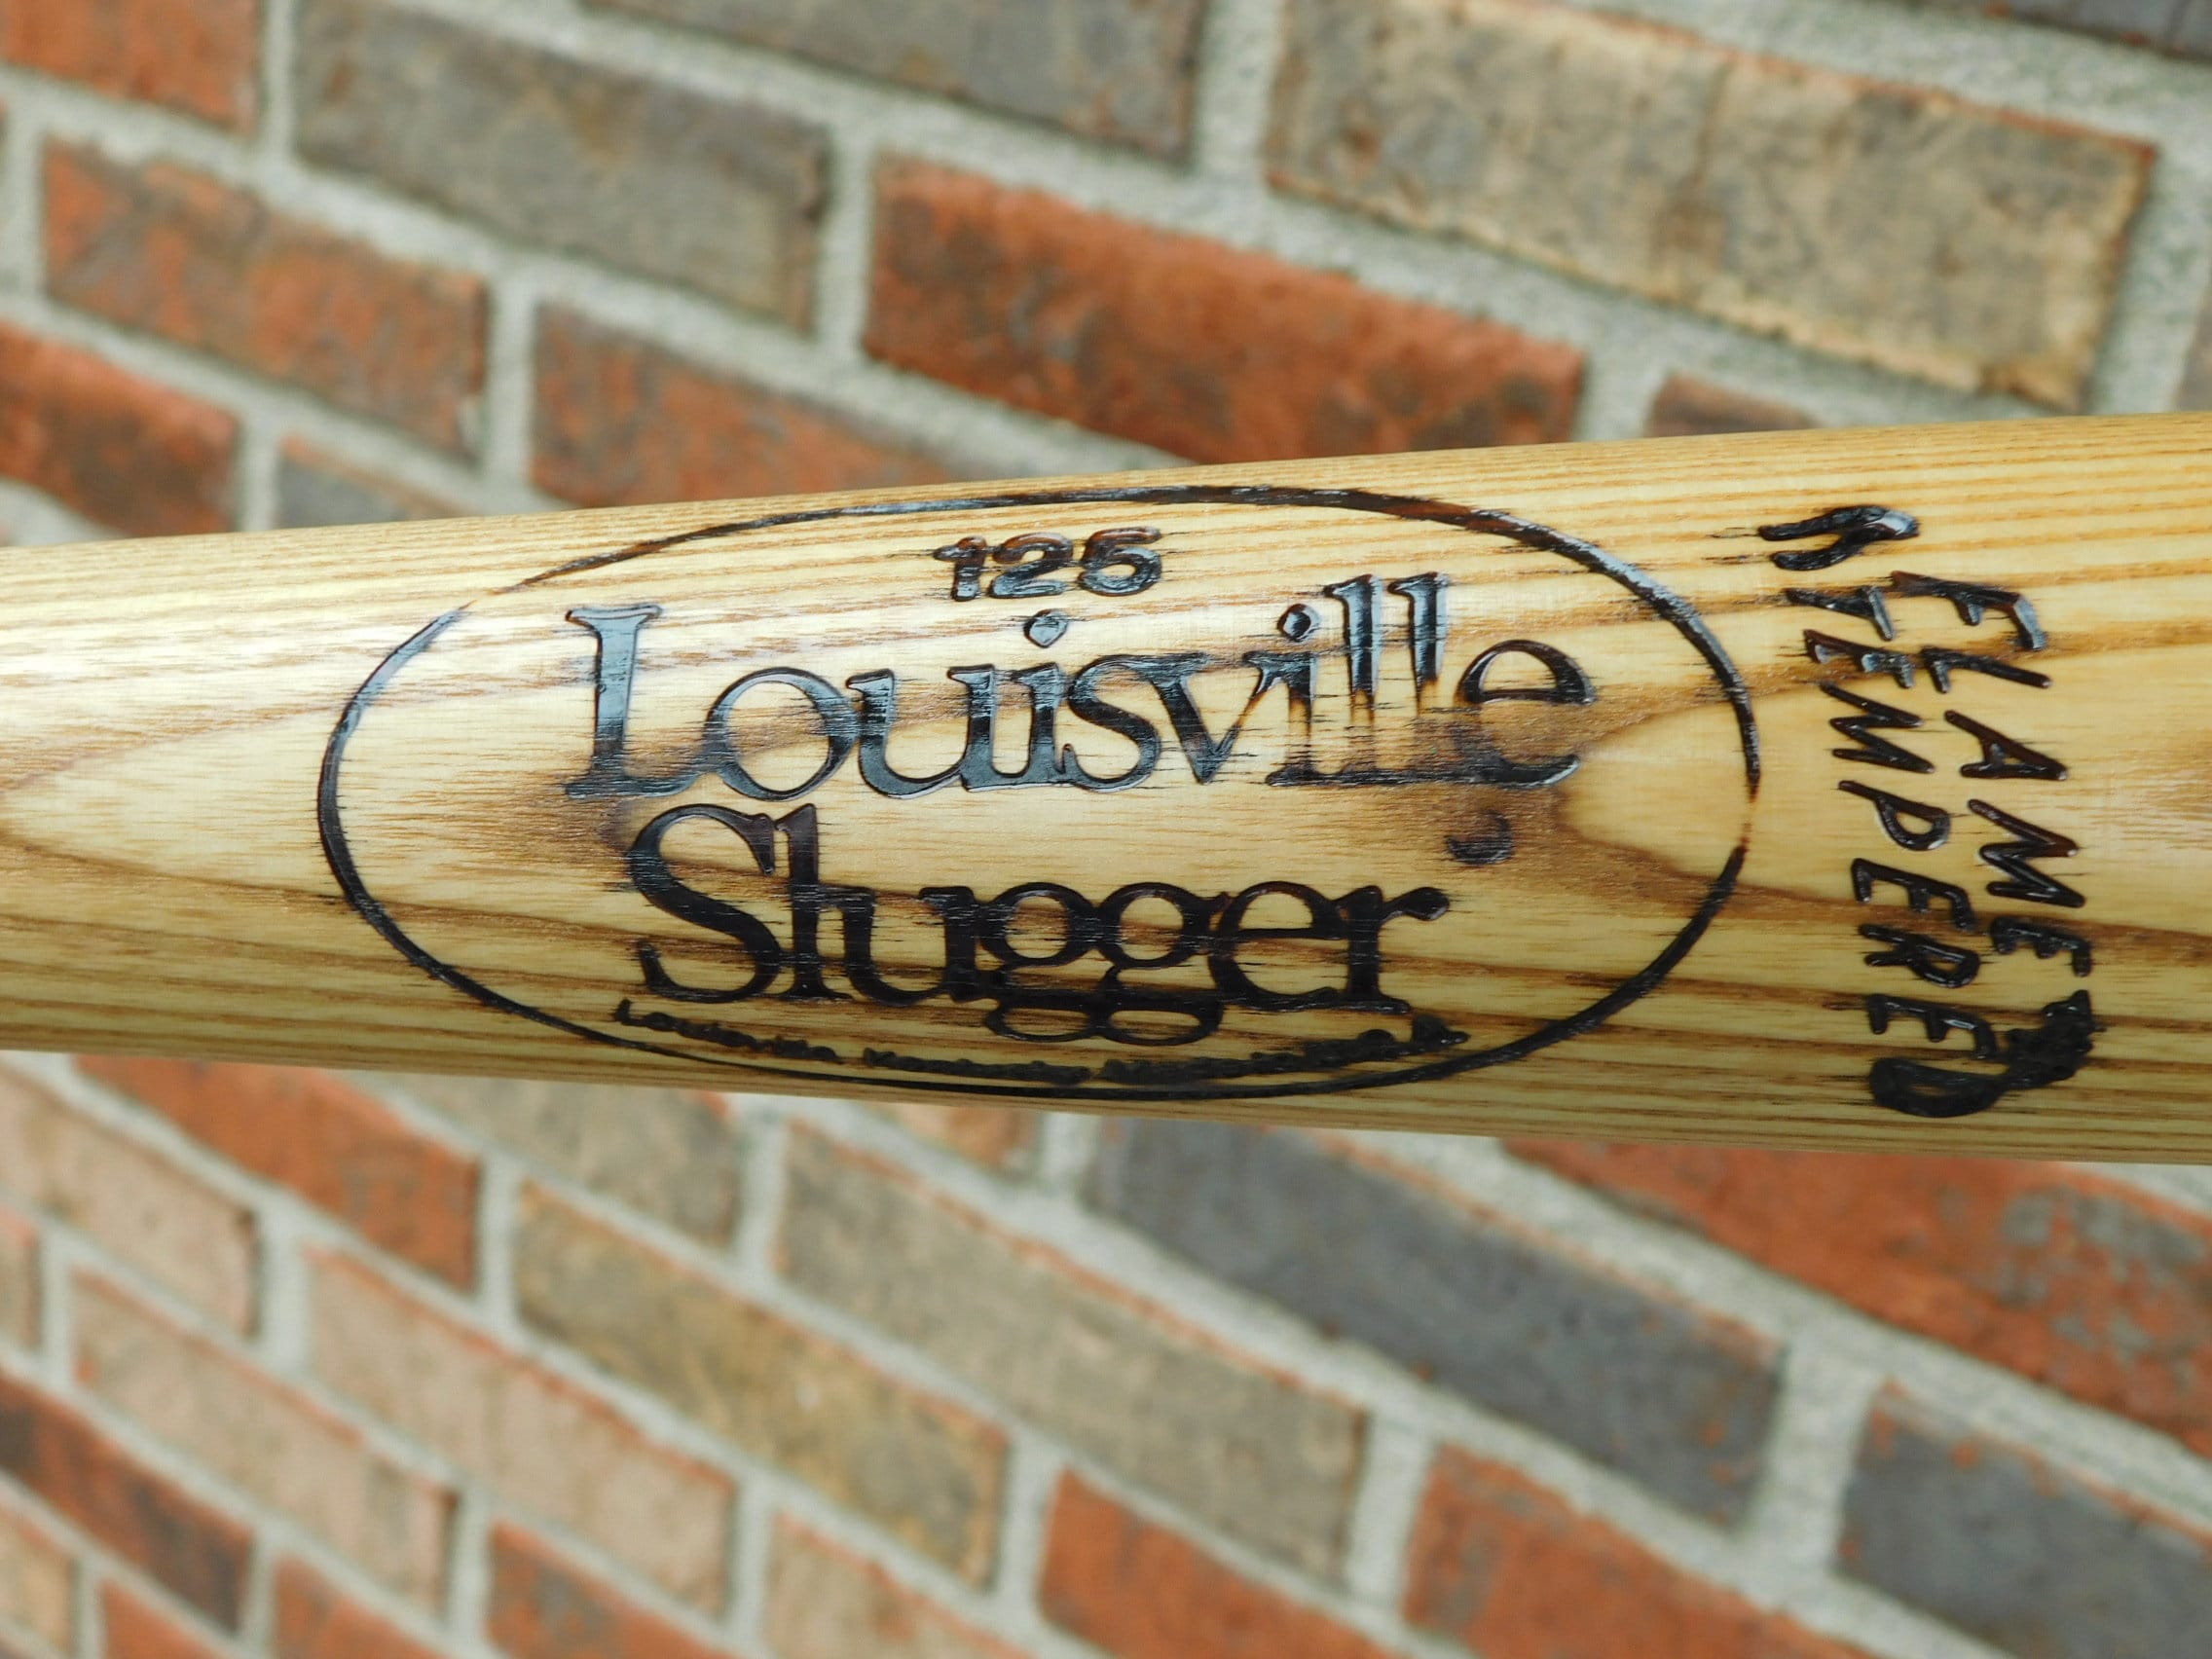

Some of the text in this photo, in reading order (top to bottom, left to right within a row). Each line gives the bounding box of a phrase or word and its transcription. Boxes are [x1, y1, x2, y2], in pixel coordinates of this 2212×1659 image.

[934, 526, 1163, 601] 125
[565, 572, 1596, 801] Louisville
[1892, 571, 2092, 977] FLAME
[625, 802, 1450, 1046] Slugger
[1785, 584, 2001, 1120] TEMPERED
